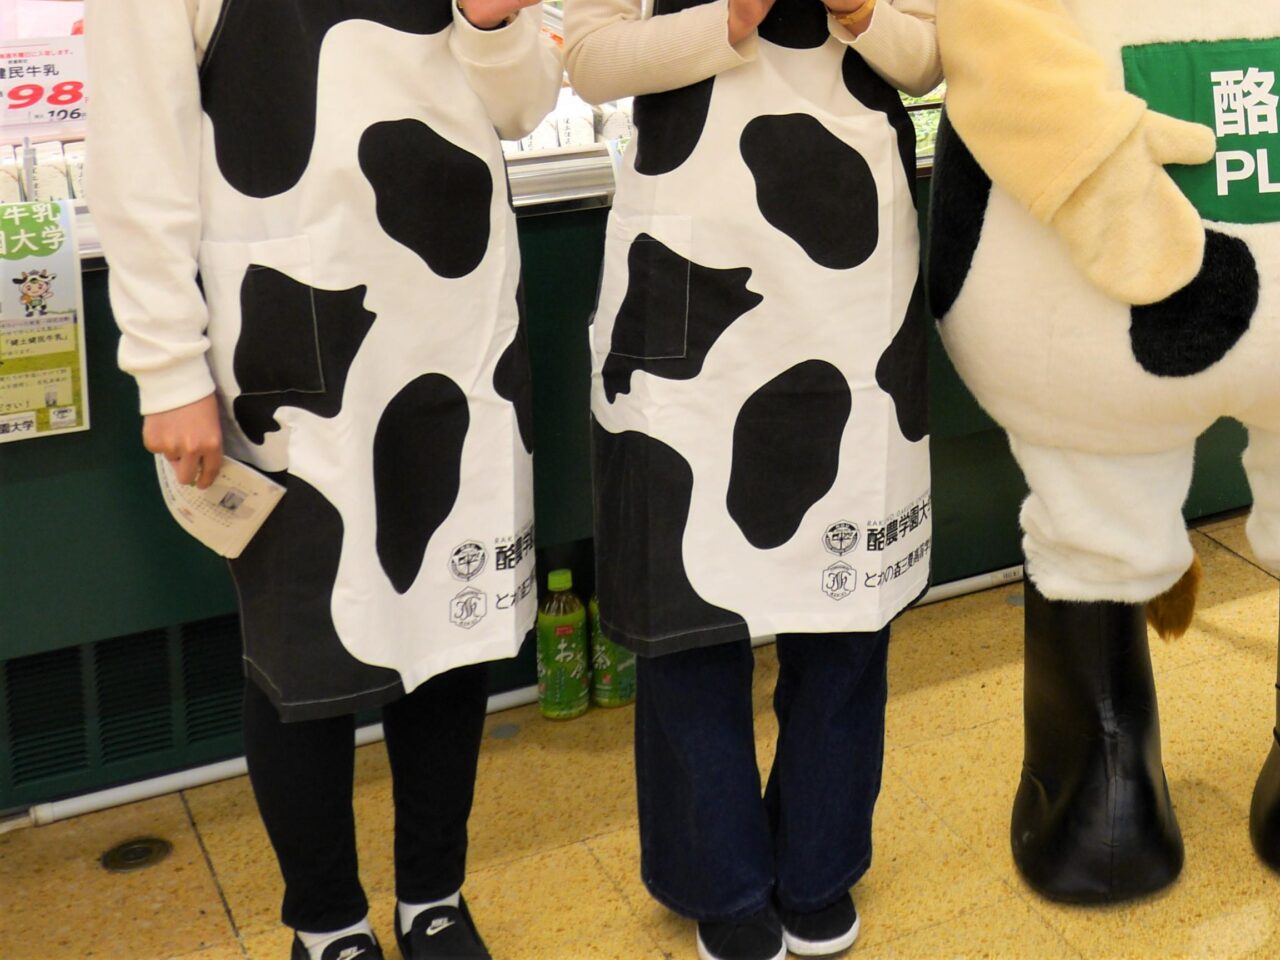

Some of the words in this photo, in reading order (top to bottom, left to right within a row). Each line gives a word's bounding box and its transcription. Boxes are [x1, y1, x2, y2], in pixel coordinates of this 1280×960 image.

[7, 81, 84, 110] 98
[3, 202, 58, 225] 牛乳
[0, 225, 66, 255] 大学
[866, 498, 931, 552] 酪農学園大
